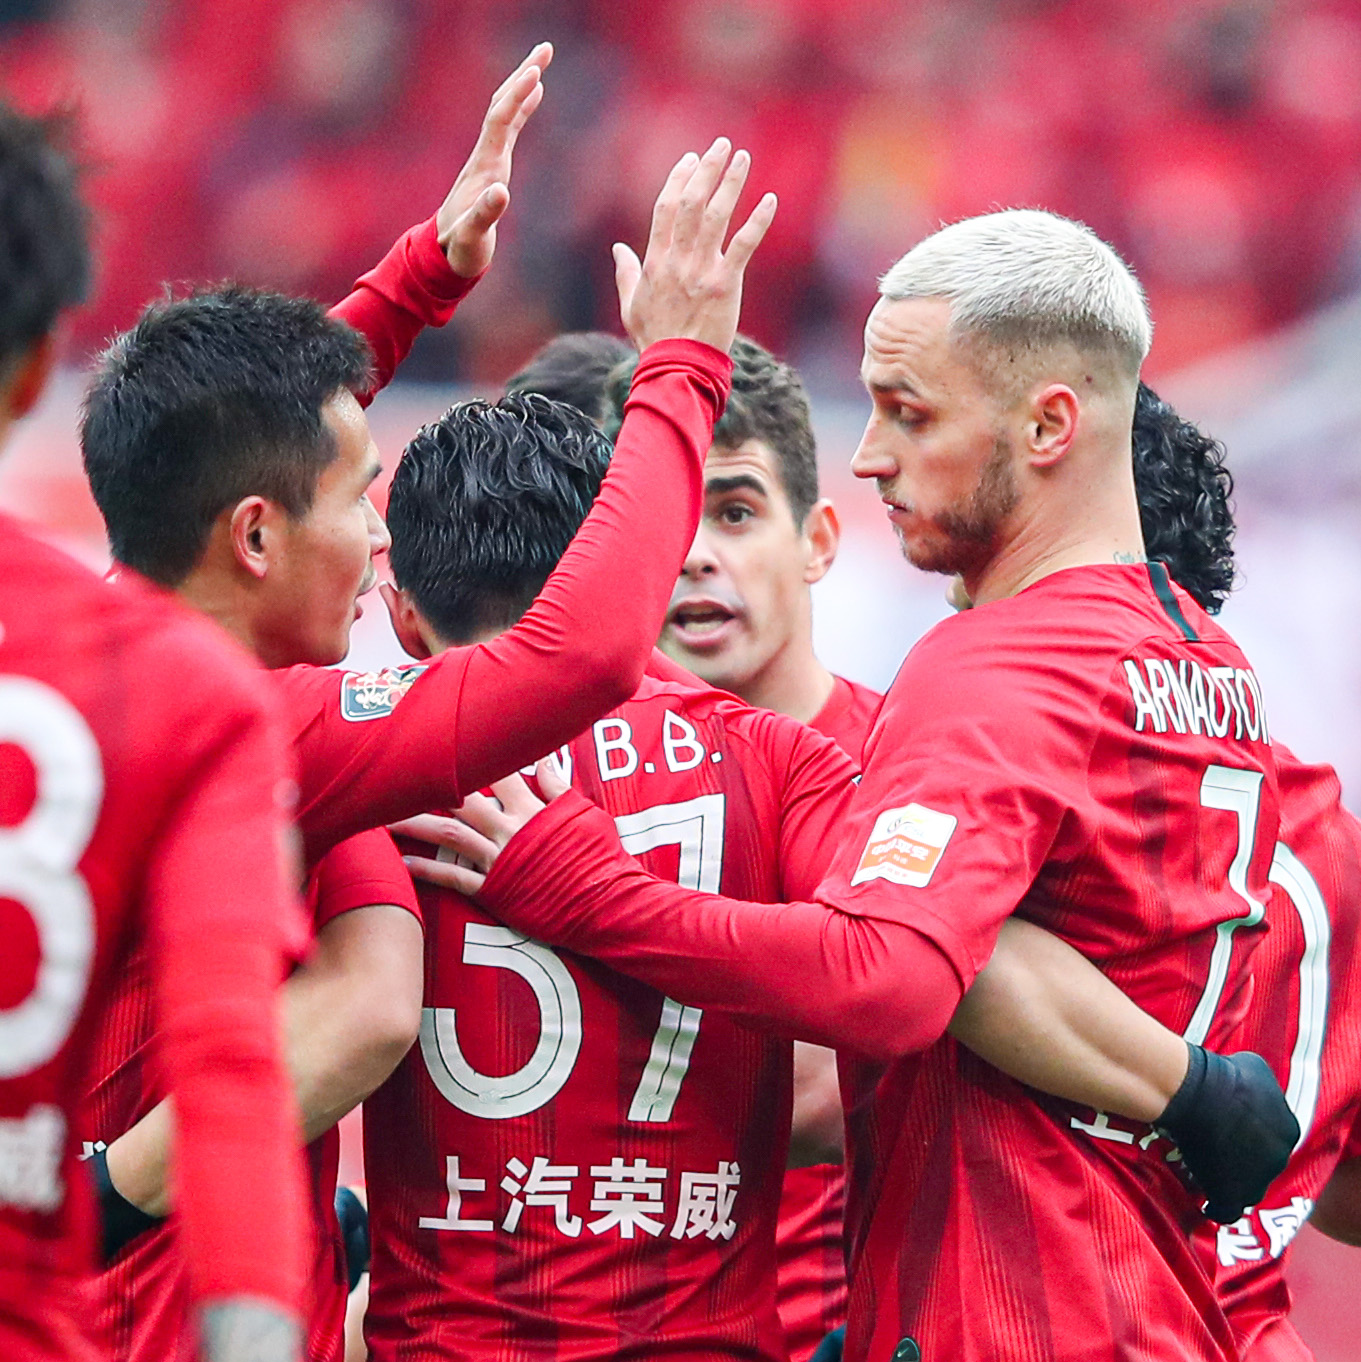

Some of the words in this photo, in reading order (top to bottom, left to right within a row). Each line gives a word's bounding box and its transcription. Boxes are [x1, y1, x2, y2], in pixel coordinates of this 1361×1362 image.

[592, 709, 723, 782] B.B.
[418, 1154, 741, 1242] 上汽荣威
